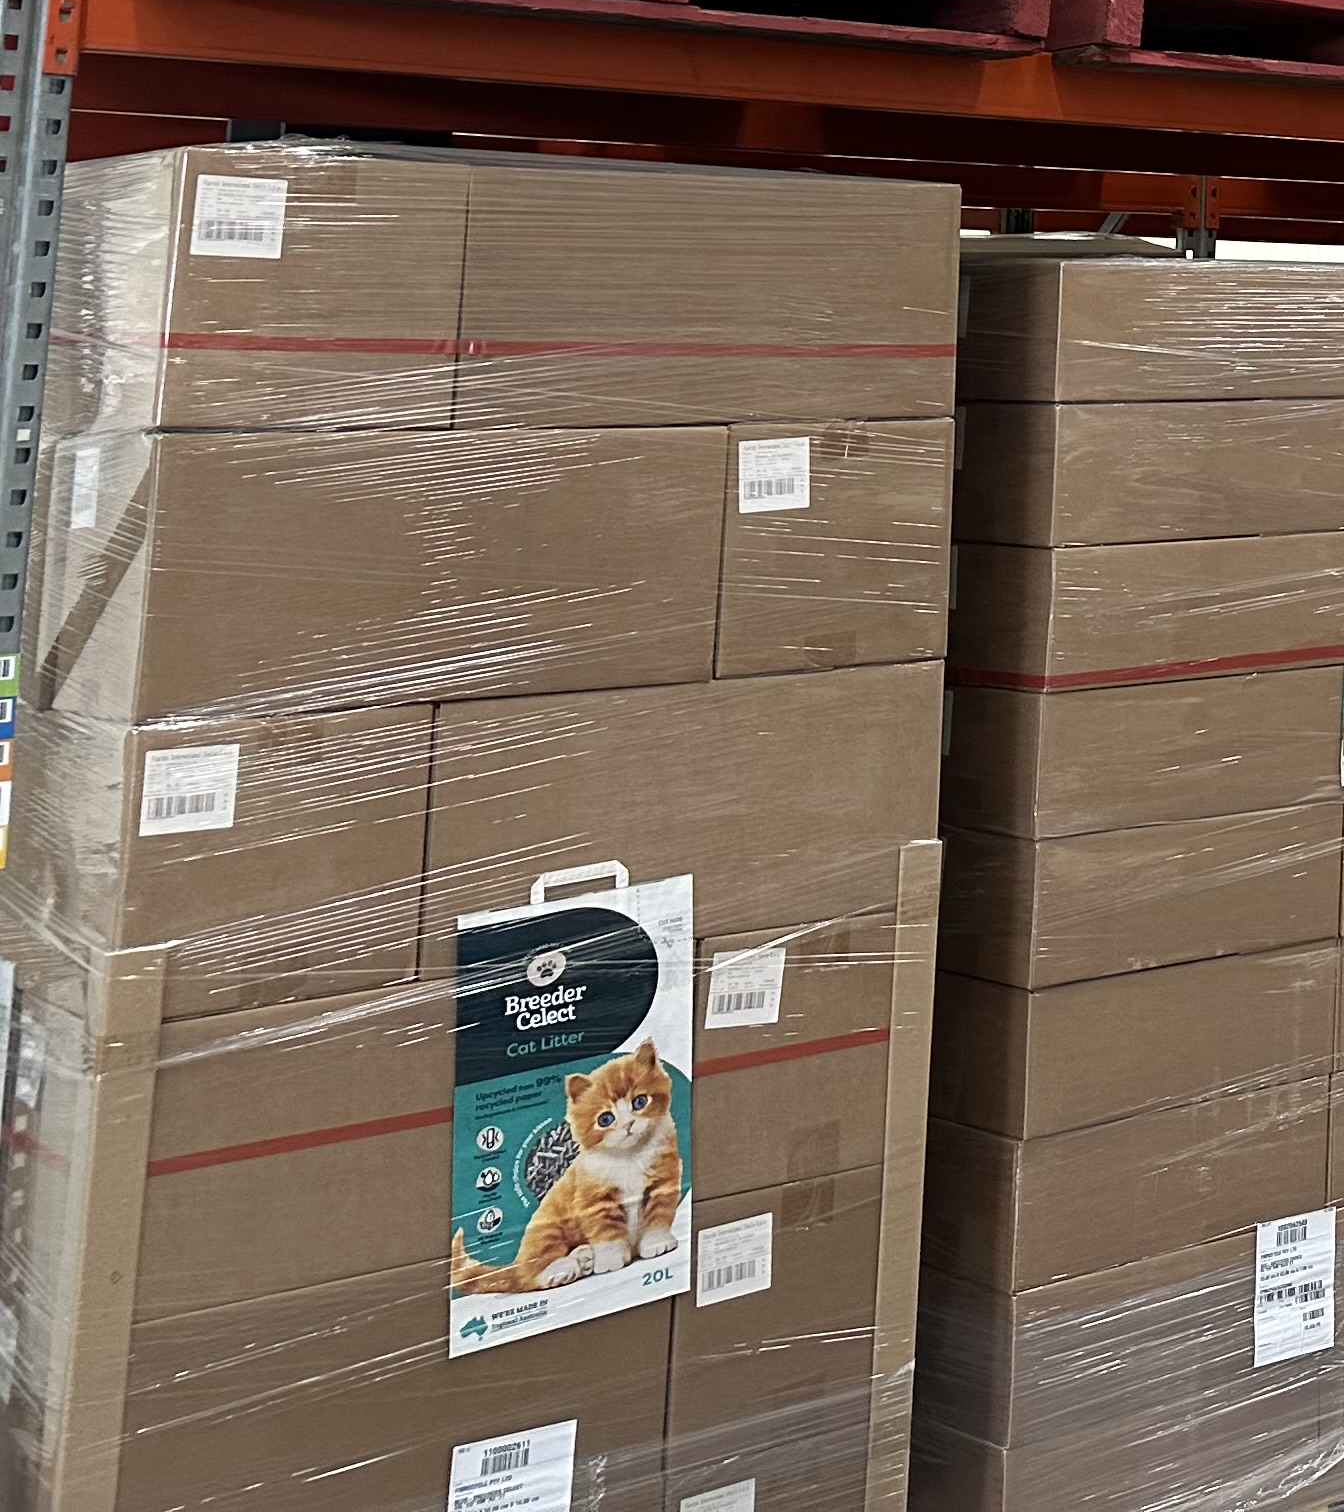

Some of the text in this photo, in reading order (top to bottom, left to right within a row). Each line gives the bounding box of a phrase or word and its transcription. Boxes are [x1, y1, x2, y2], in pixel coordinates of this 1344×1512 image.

[504, 985, 587, 1016] Breeder
[516, 1004, 576, 1030] Celect
[506, 1032, 585, 1057] Cat Litter
[535, 1074, 562, 1087] 99%
[642, 1267, 673, 1286] 20L
